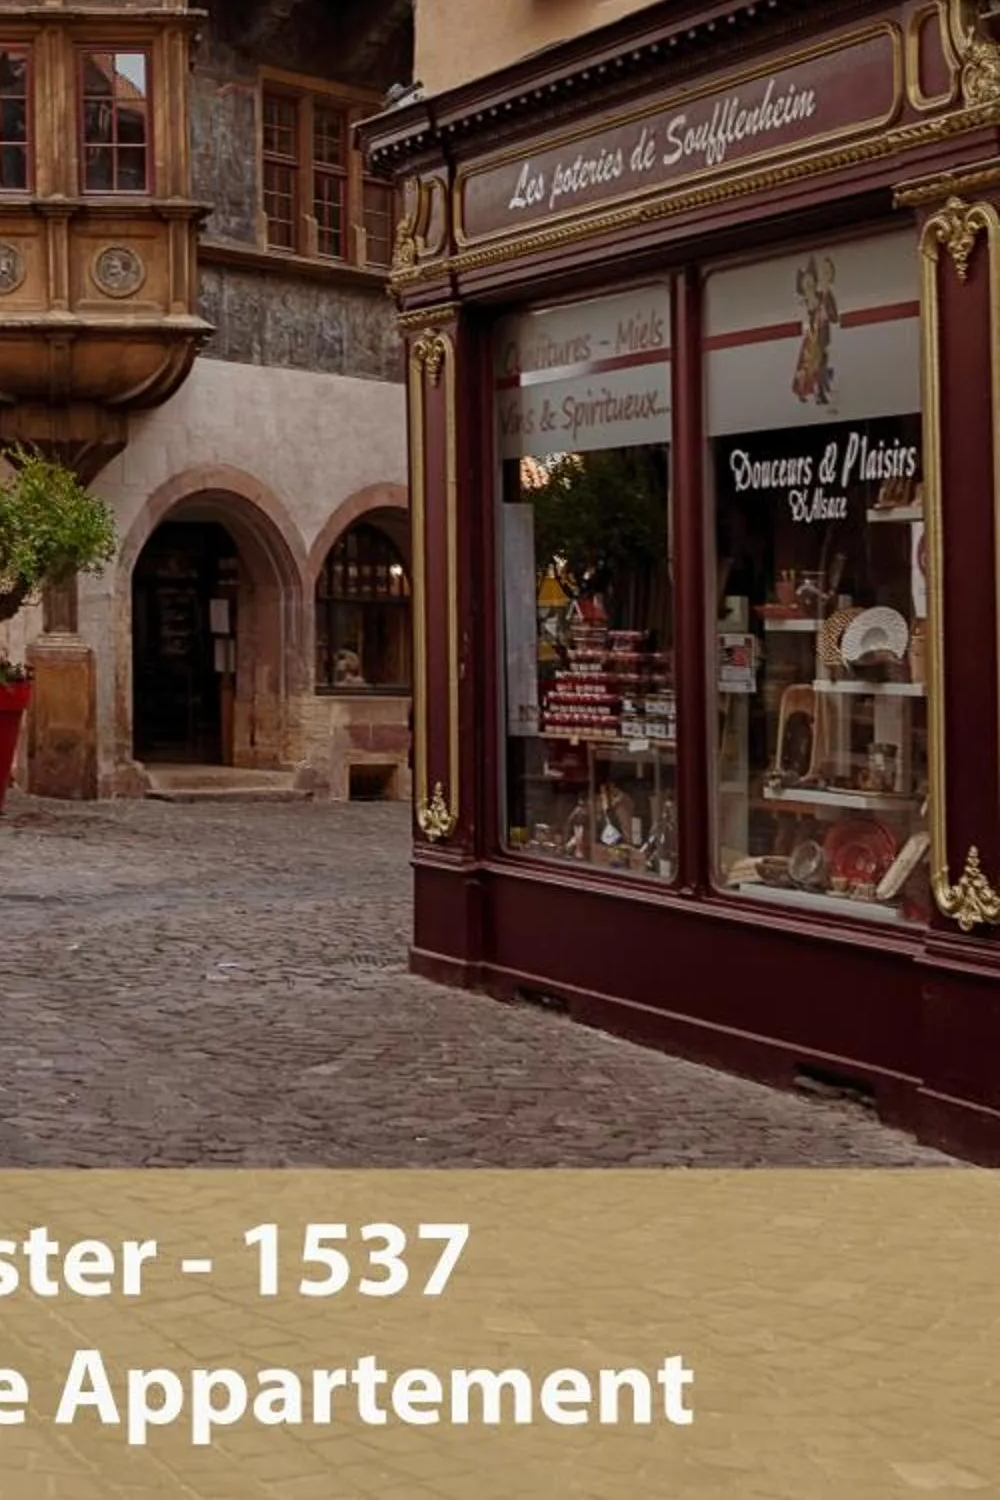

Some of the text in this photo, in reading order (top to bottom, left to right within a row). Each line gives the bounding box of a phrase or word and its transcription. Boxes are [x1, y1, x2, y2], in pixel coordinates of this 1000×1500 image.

[508, 79, 816, 209] Les poteries de Soufflenheim
[614, 307, 665, 355] Miels
[538, 400, 558, 432] &
[729, 431, 918, 491] Douceurs & Plaisirs
[788, 486, 849, 524] D'Alsace
